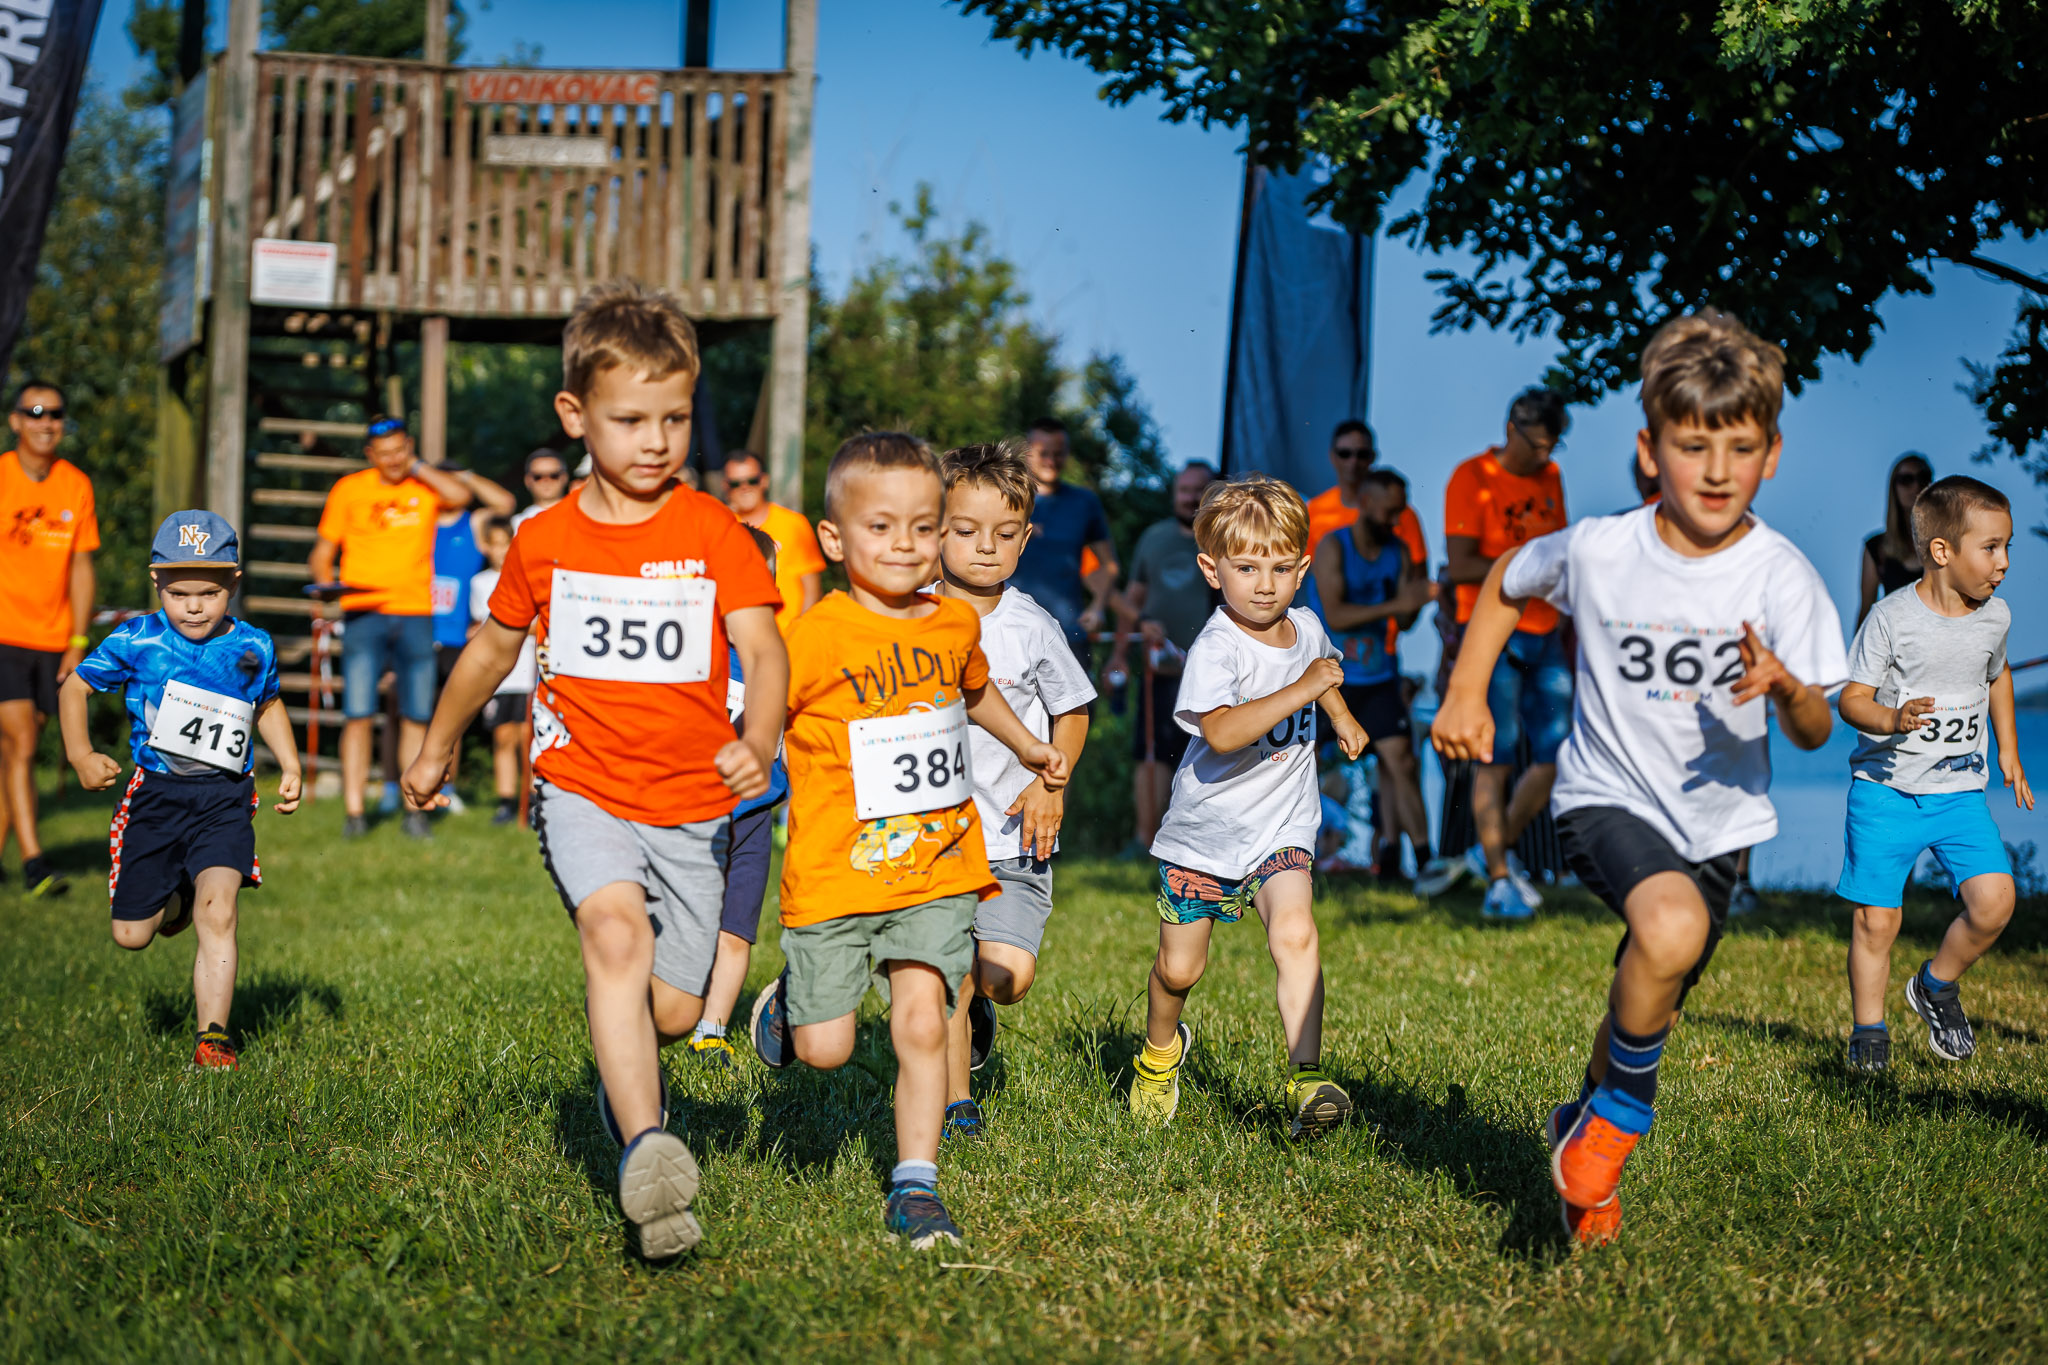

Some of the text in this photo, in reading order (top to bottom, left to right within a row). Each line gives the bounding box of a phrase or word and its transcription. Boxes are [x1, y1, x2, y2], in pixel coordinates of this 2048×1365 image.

[467, 73, 656, 102] VIDIKOVAC
[179, 525, 211, 555] NY
[640, 559, 705, 577] CHILLIN
[582, 616, 684, 662] 350
[1618, 636, 1744, 686] 362
[179, 716, 246, 758] 413
[1249, 706, 1311, 748] 05
[1919, 712, 1979, 743] 325
[893, 741, 966, 794] 384
[1260, 751, 1289, 762] VIGO
